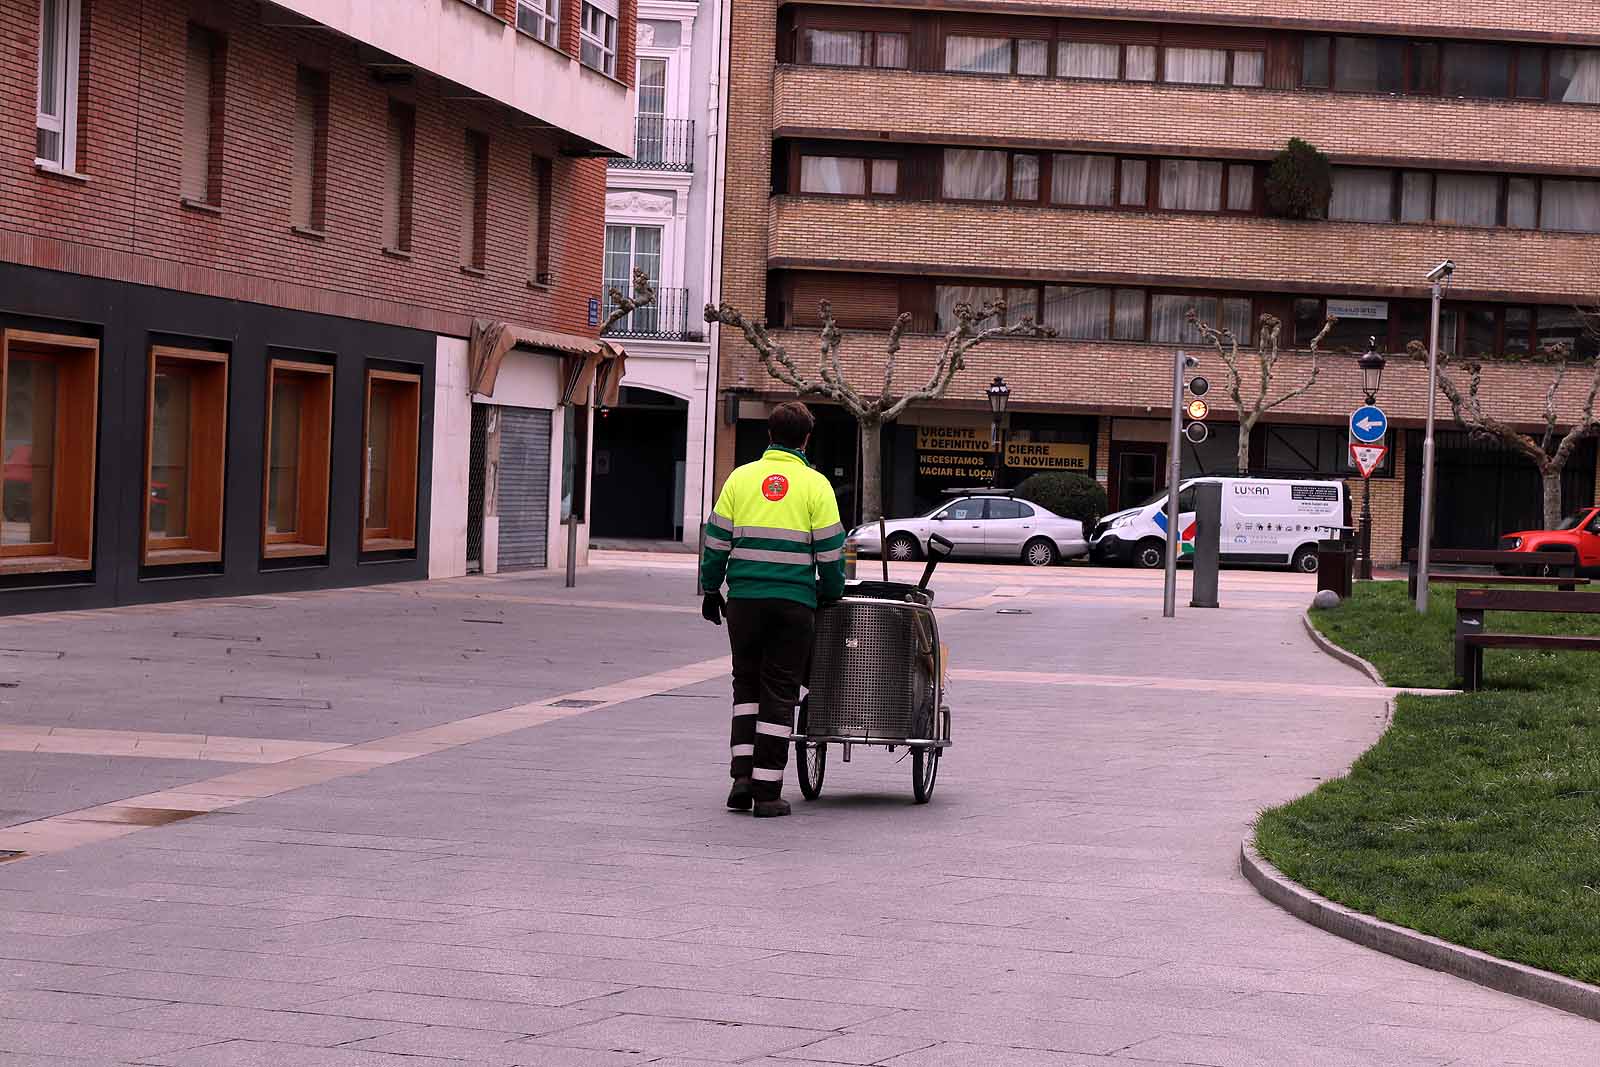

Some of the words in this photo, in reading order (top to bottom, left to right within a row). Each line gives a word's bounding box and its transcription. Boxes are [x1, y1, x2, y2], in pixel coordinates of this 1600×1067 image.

[921, 426, 975, 438] URGENTE
[921, 438, 928, 447] Y
[931, 439, 989, 450] DEFINITIVO
[1008, 444, 1049, 455] CIERRE
[920, 454, 984, 465] NECESITAMOS
[1008, 456, 1020, 465] 30
[1023, 456, 1084, 467] NOVIEMBRE
[919, 466, 953, 476] VACIAR
[955, 468, 967, 476] EL
